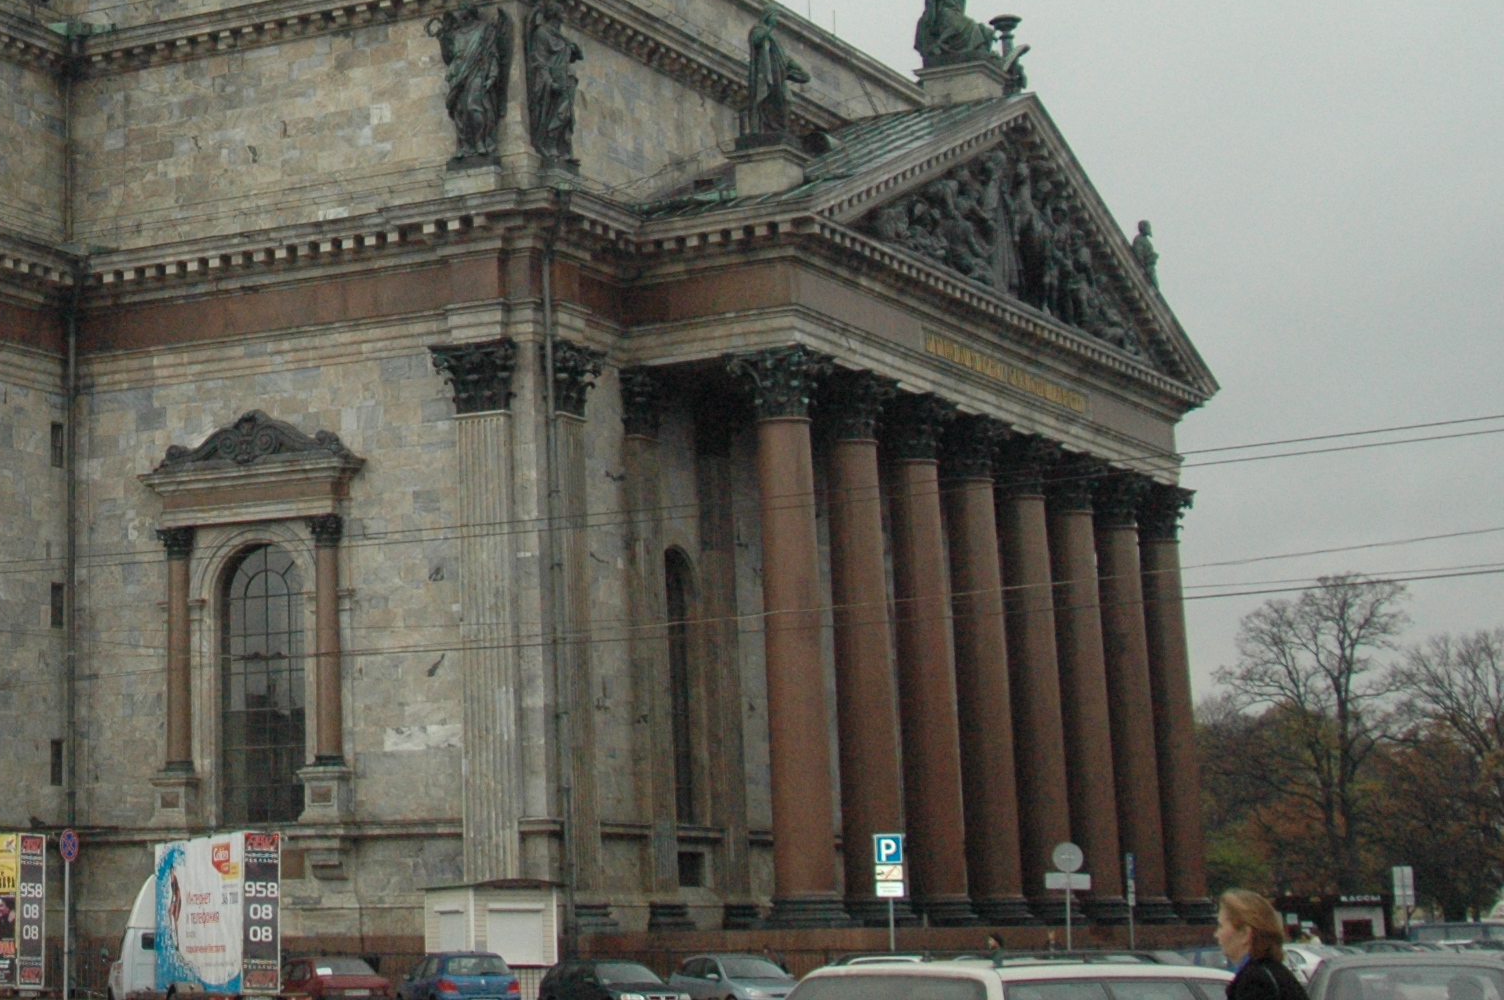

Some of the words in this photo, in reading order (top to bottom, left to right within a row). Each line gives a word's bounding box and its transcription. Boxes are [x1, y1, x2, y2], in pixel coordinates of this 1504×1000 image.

[20, 882, 43, 898] 958
[244, 881, 278, 898] 958
[23, 903, 39, 919] 08
[249, 903, 273, 920] 08
[22, 924, 39, 940] 08
[249, 926, 273, 942] 08
